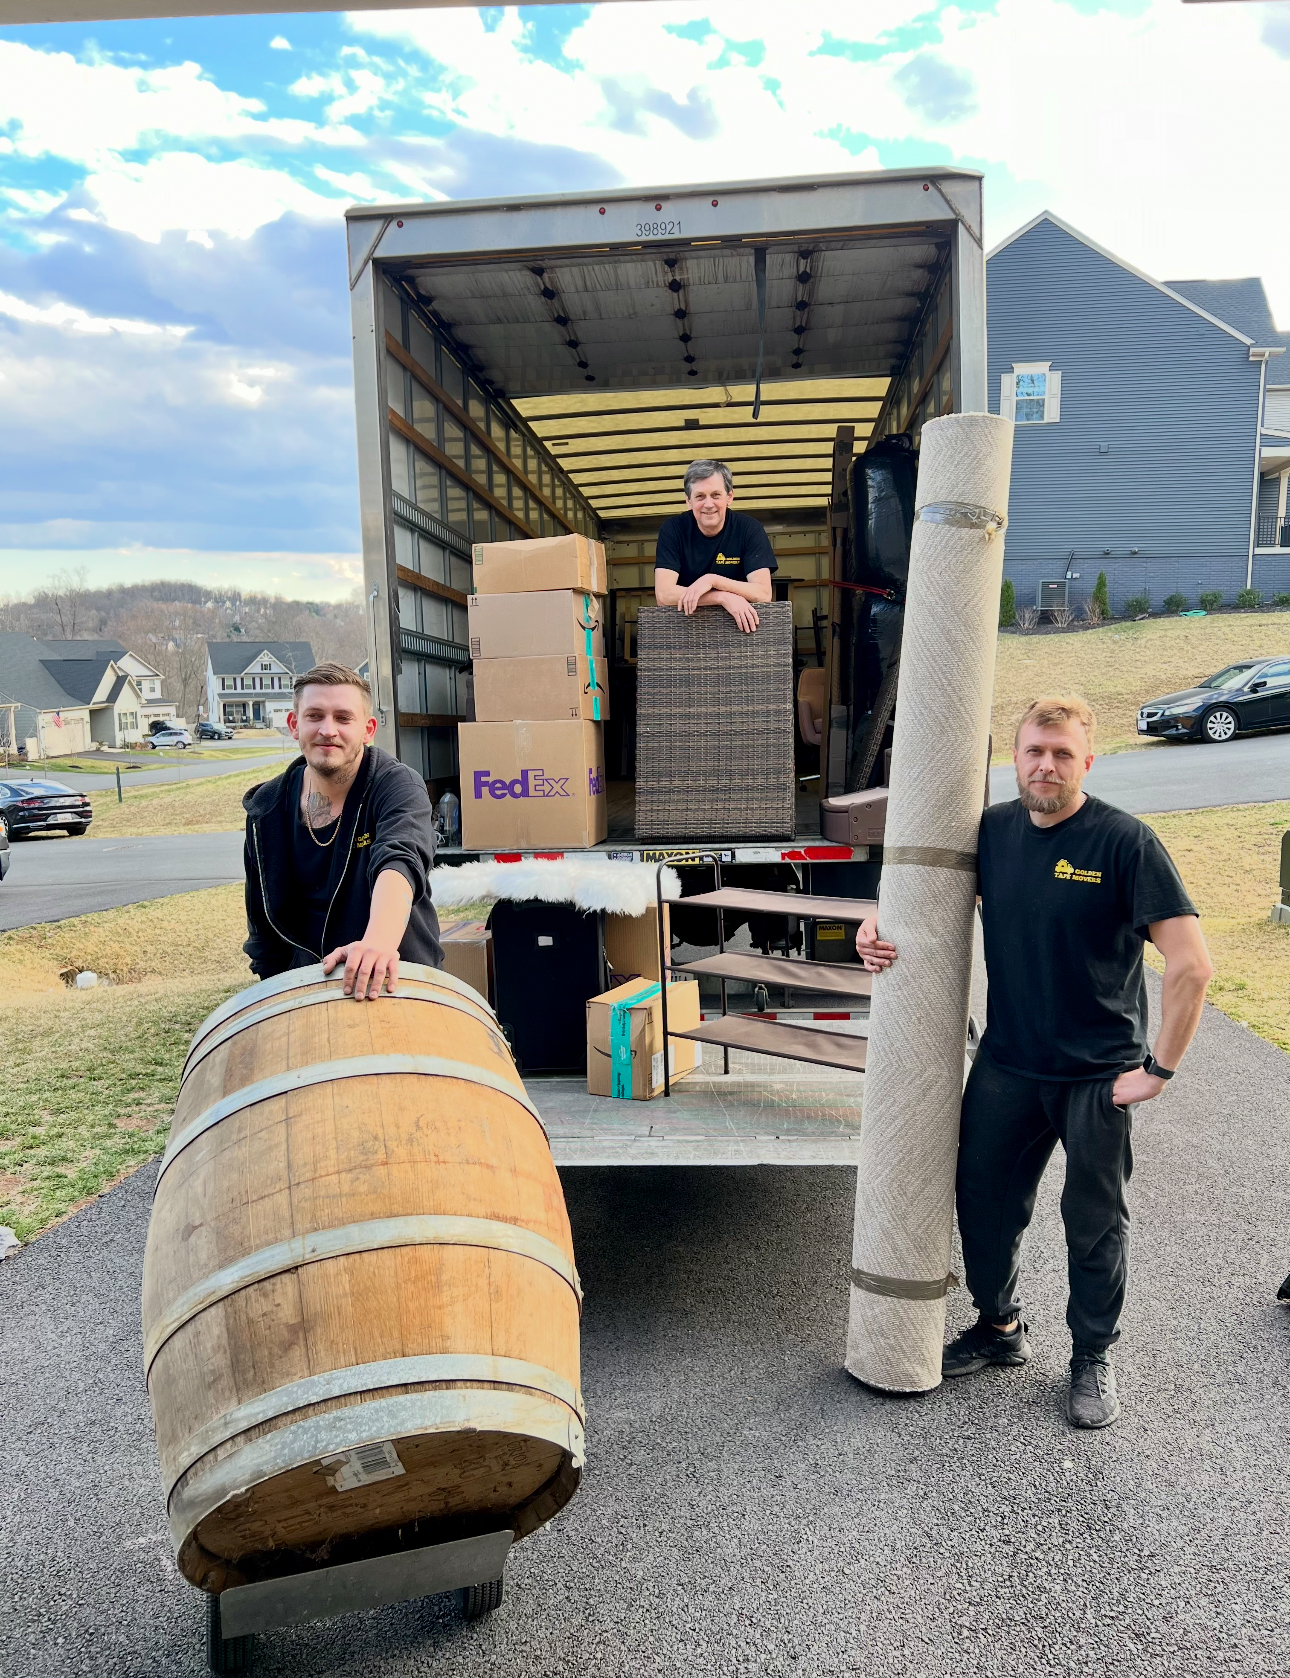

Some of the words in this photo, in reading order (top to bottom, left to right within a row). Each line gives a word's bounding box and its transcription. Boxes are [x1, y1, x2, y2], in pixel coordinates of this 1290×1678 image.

[635, 220, 682, 238] 398921
[473, 768, 570, 800] FedEx
[1054, 872, 1071, 880] TAPE
[1072, 875, 1102, 883] MOVERS
[1075, 869, 1102, 877] GOLDEN
